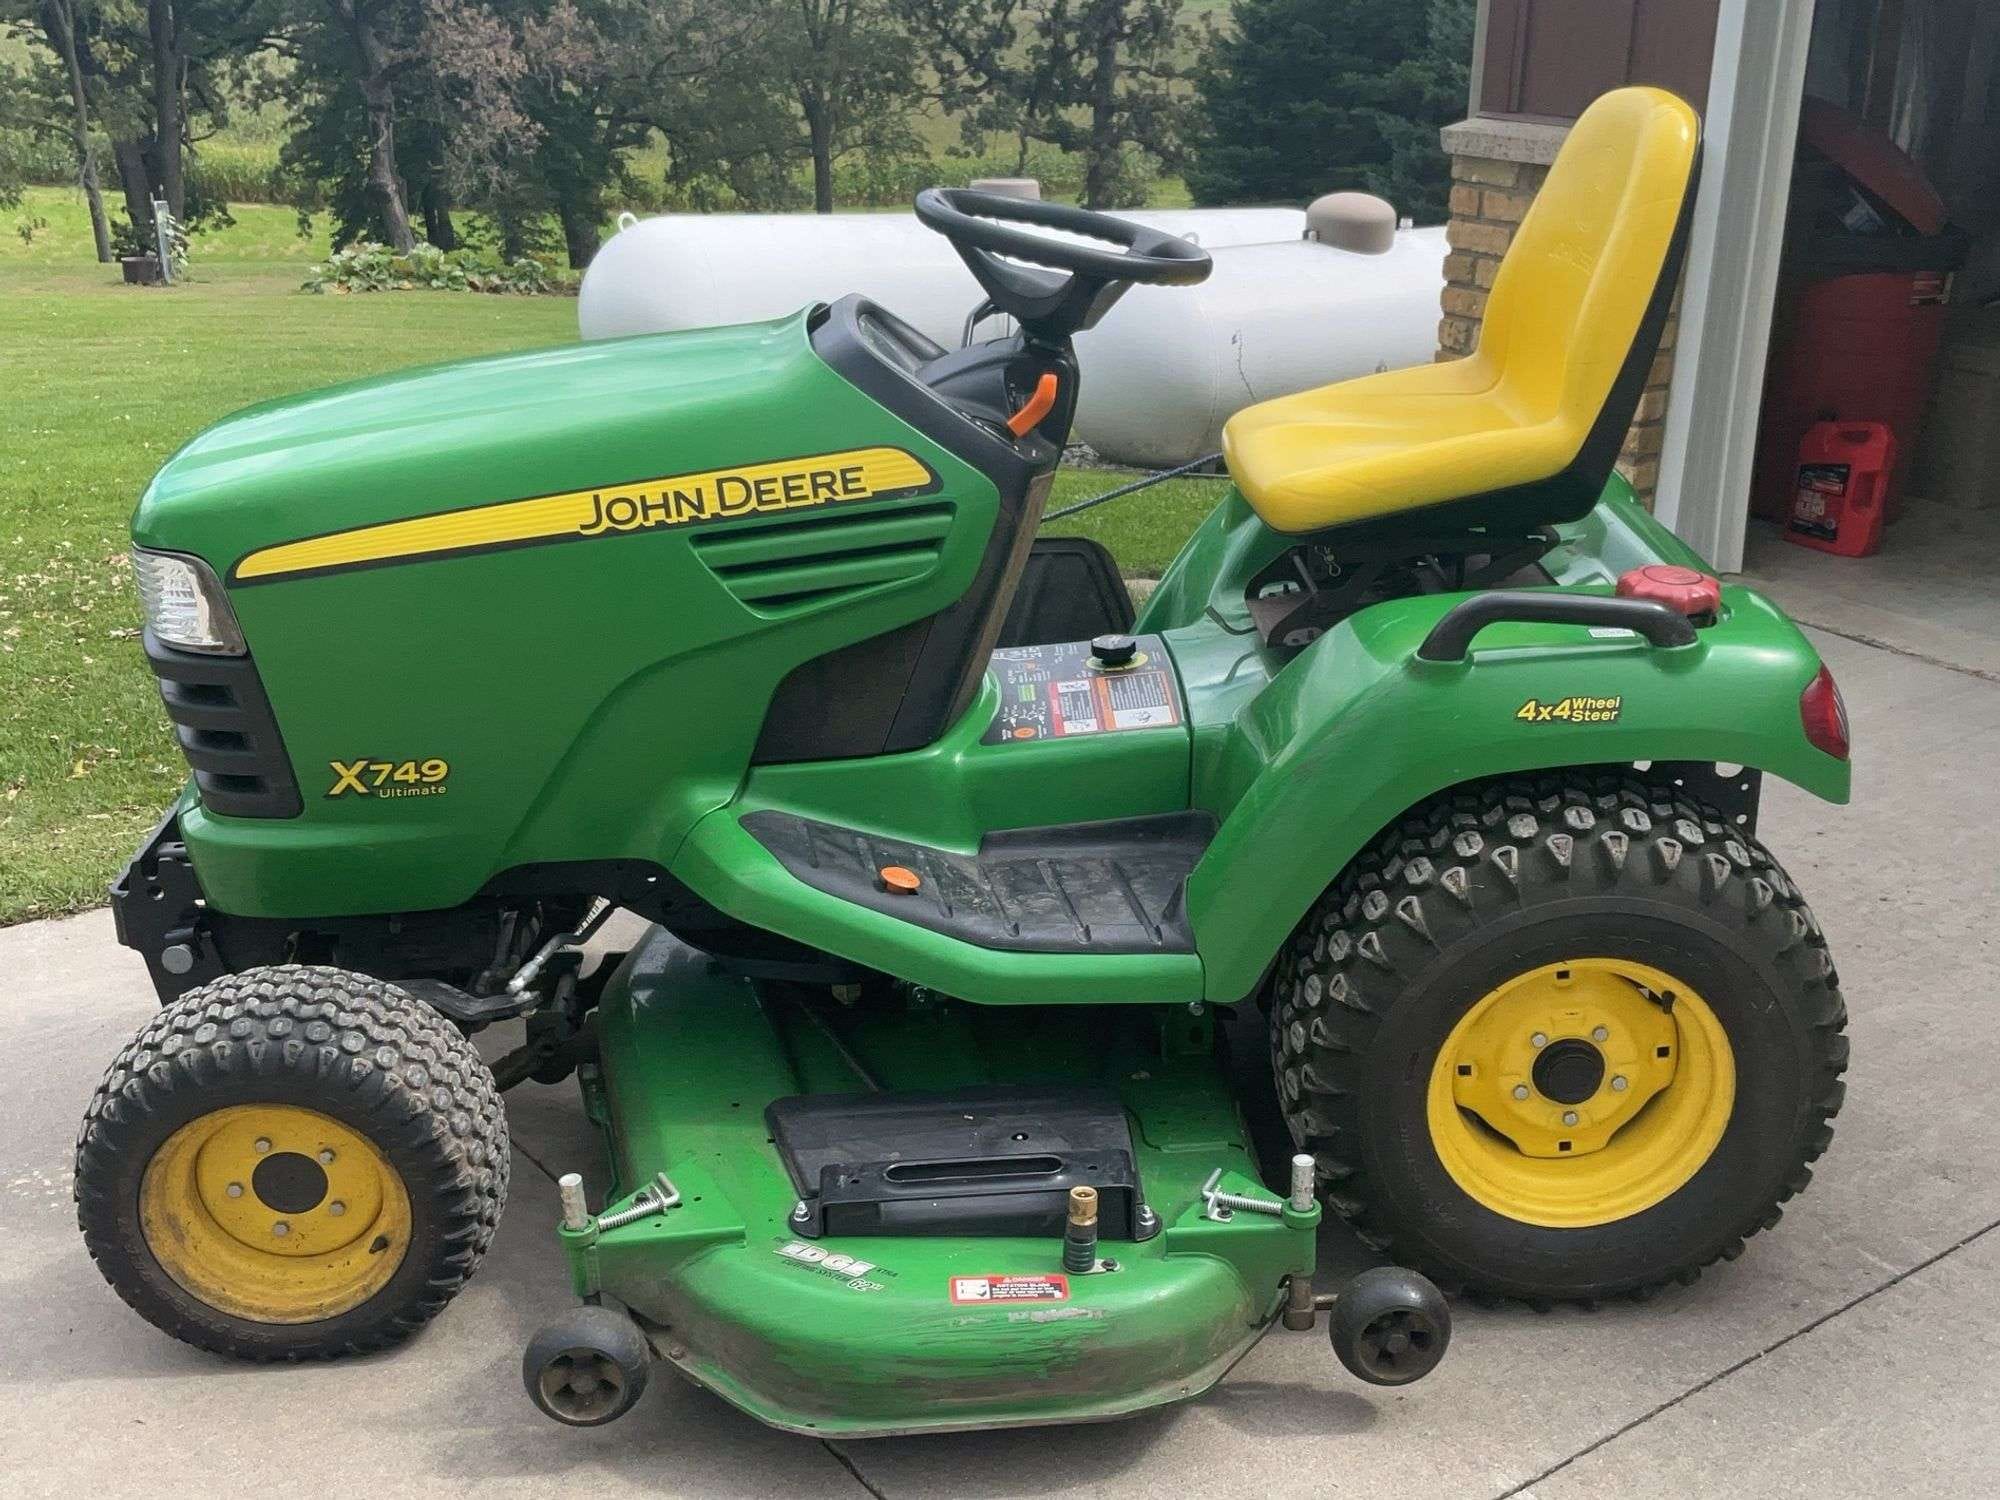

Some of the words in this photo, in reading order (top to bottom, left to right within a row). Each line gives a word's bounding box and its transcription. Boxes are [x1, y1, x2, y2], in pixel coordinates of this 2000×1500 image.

[579, 487, 706, 531] JOHN
[716, 466, 868, 511] DEERE
[1517, 699, 1572, 721] 4x4
[1572, 696, 1621, 710] Wheel
[1571, 709, 1619, 722] Steer
[328, 759, 449, 795] X749
[379, 785, 447, 798] Ultimate
